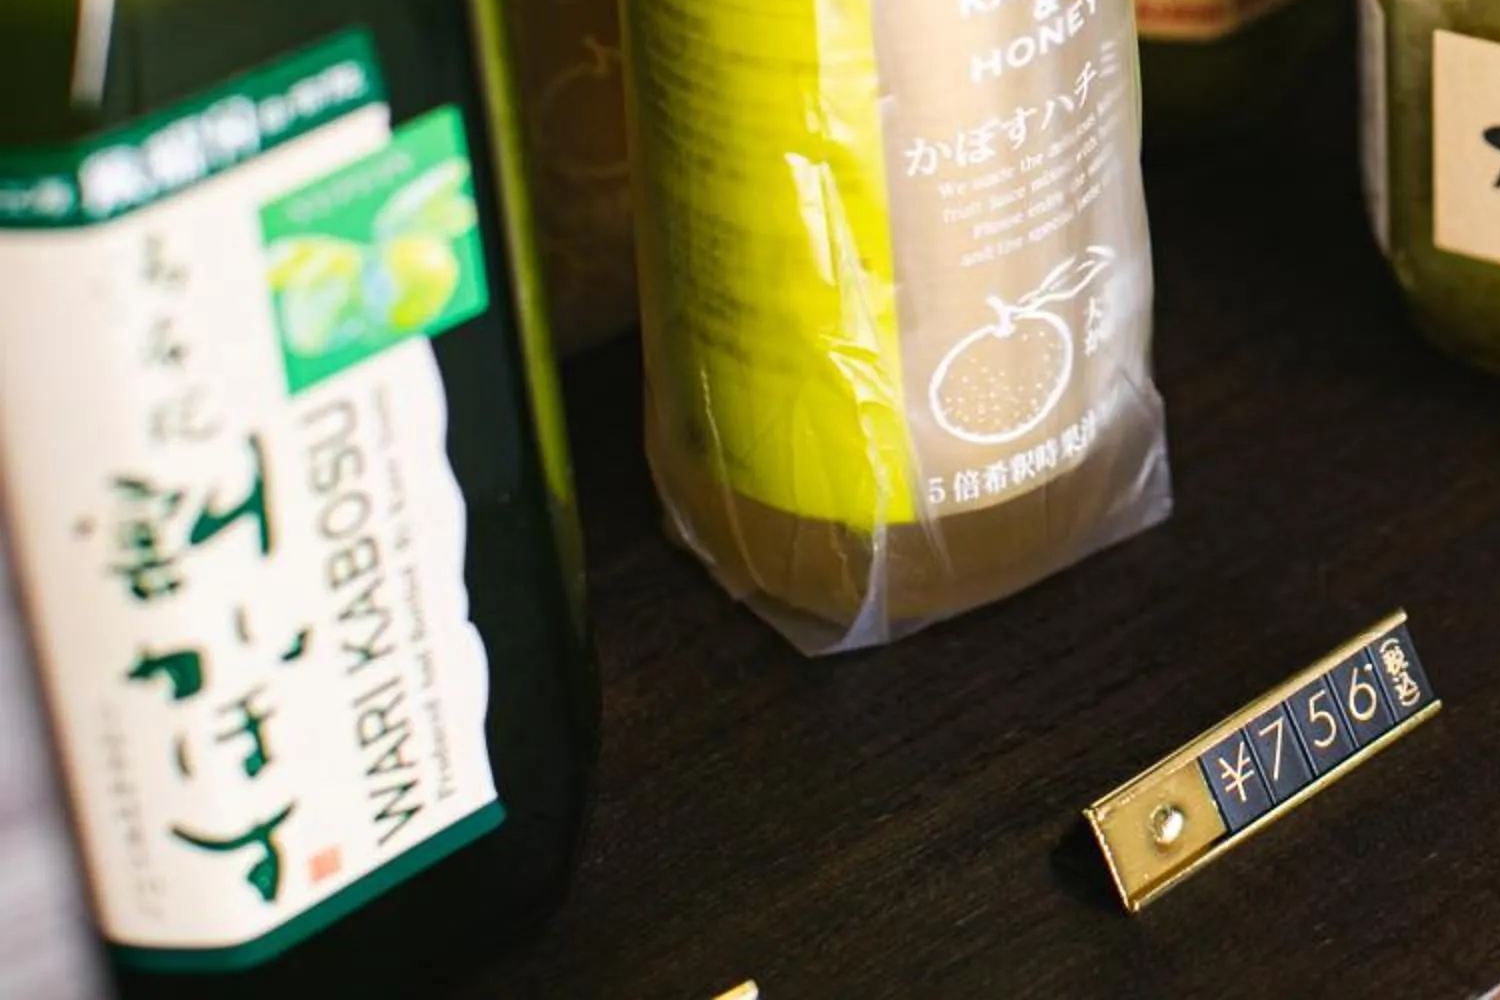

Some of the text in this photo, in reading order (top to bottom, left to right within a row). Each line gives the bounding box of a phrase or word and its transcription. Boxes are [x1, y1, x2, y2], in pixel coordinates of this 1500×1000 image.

[300, 397, 425, 849] WARI KABOSU
[1218, 666, 1378, 803] ¥756
